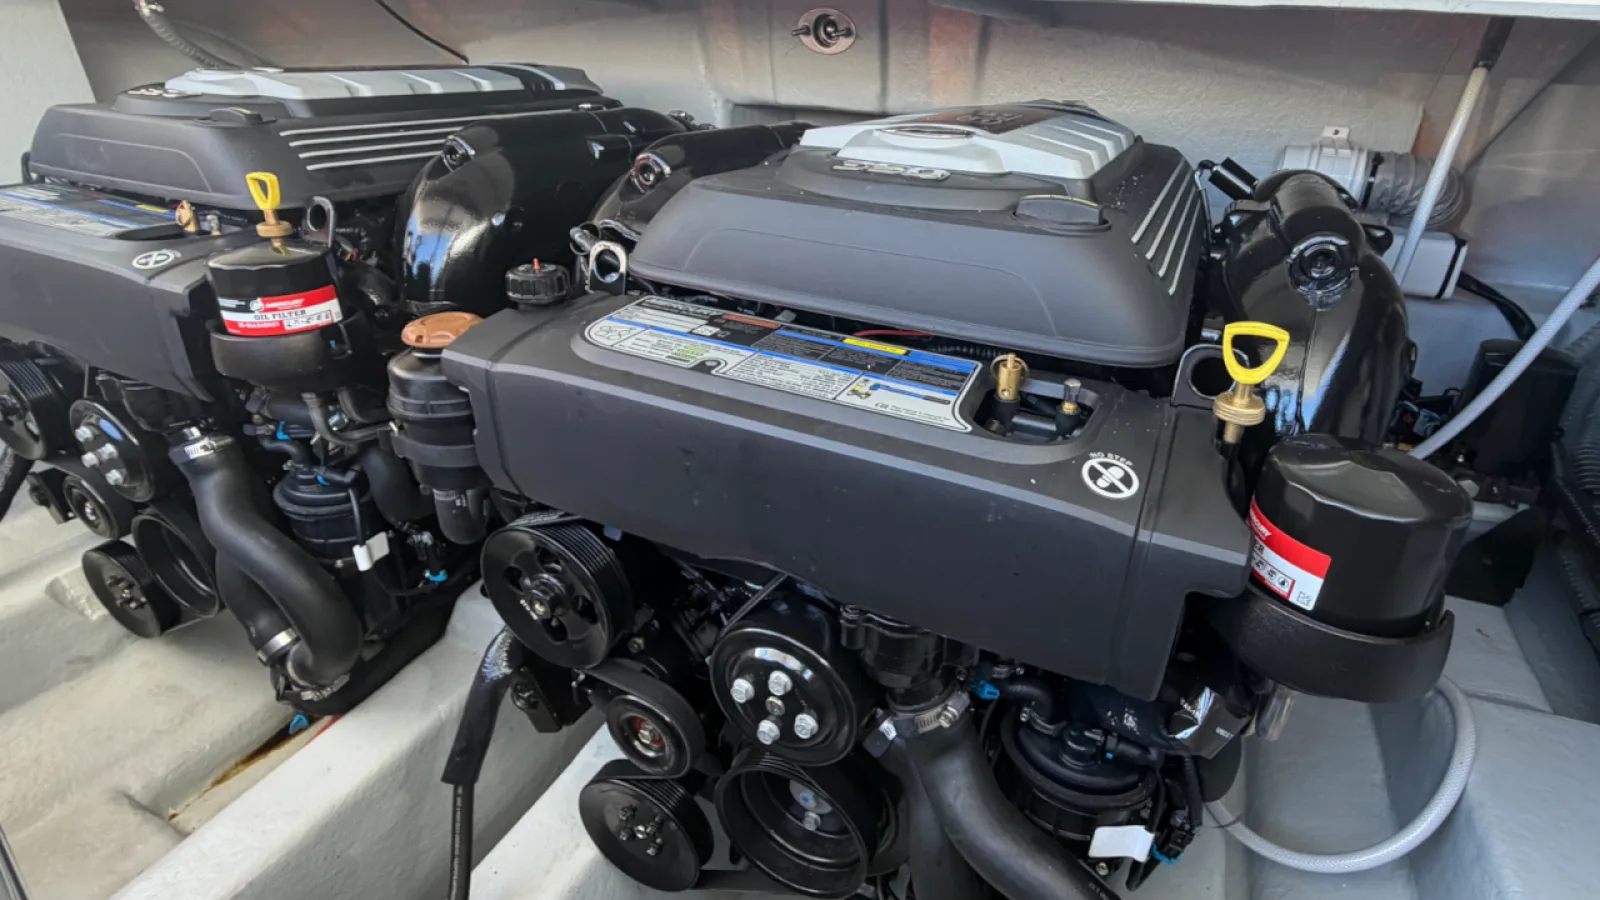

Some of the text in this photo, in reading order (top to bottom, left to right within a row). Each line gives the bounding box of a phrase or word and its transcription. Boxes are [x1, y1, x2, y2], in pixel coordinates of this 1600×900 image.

[254, 313, 271, 321] OIL
[272, 309, 307, 321] FILTER
[1089, 451, 1134, 466] NO STEP
